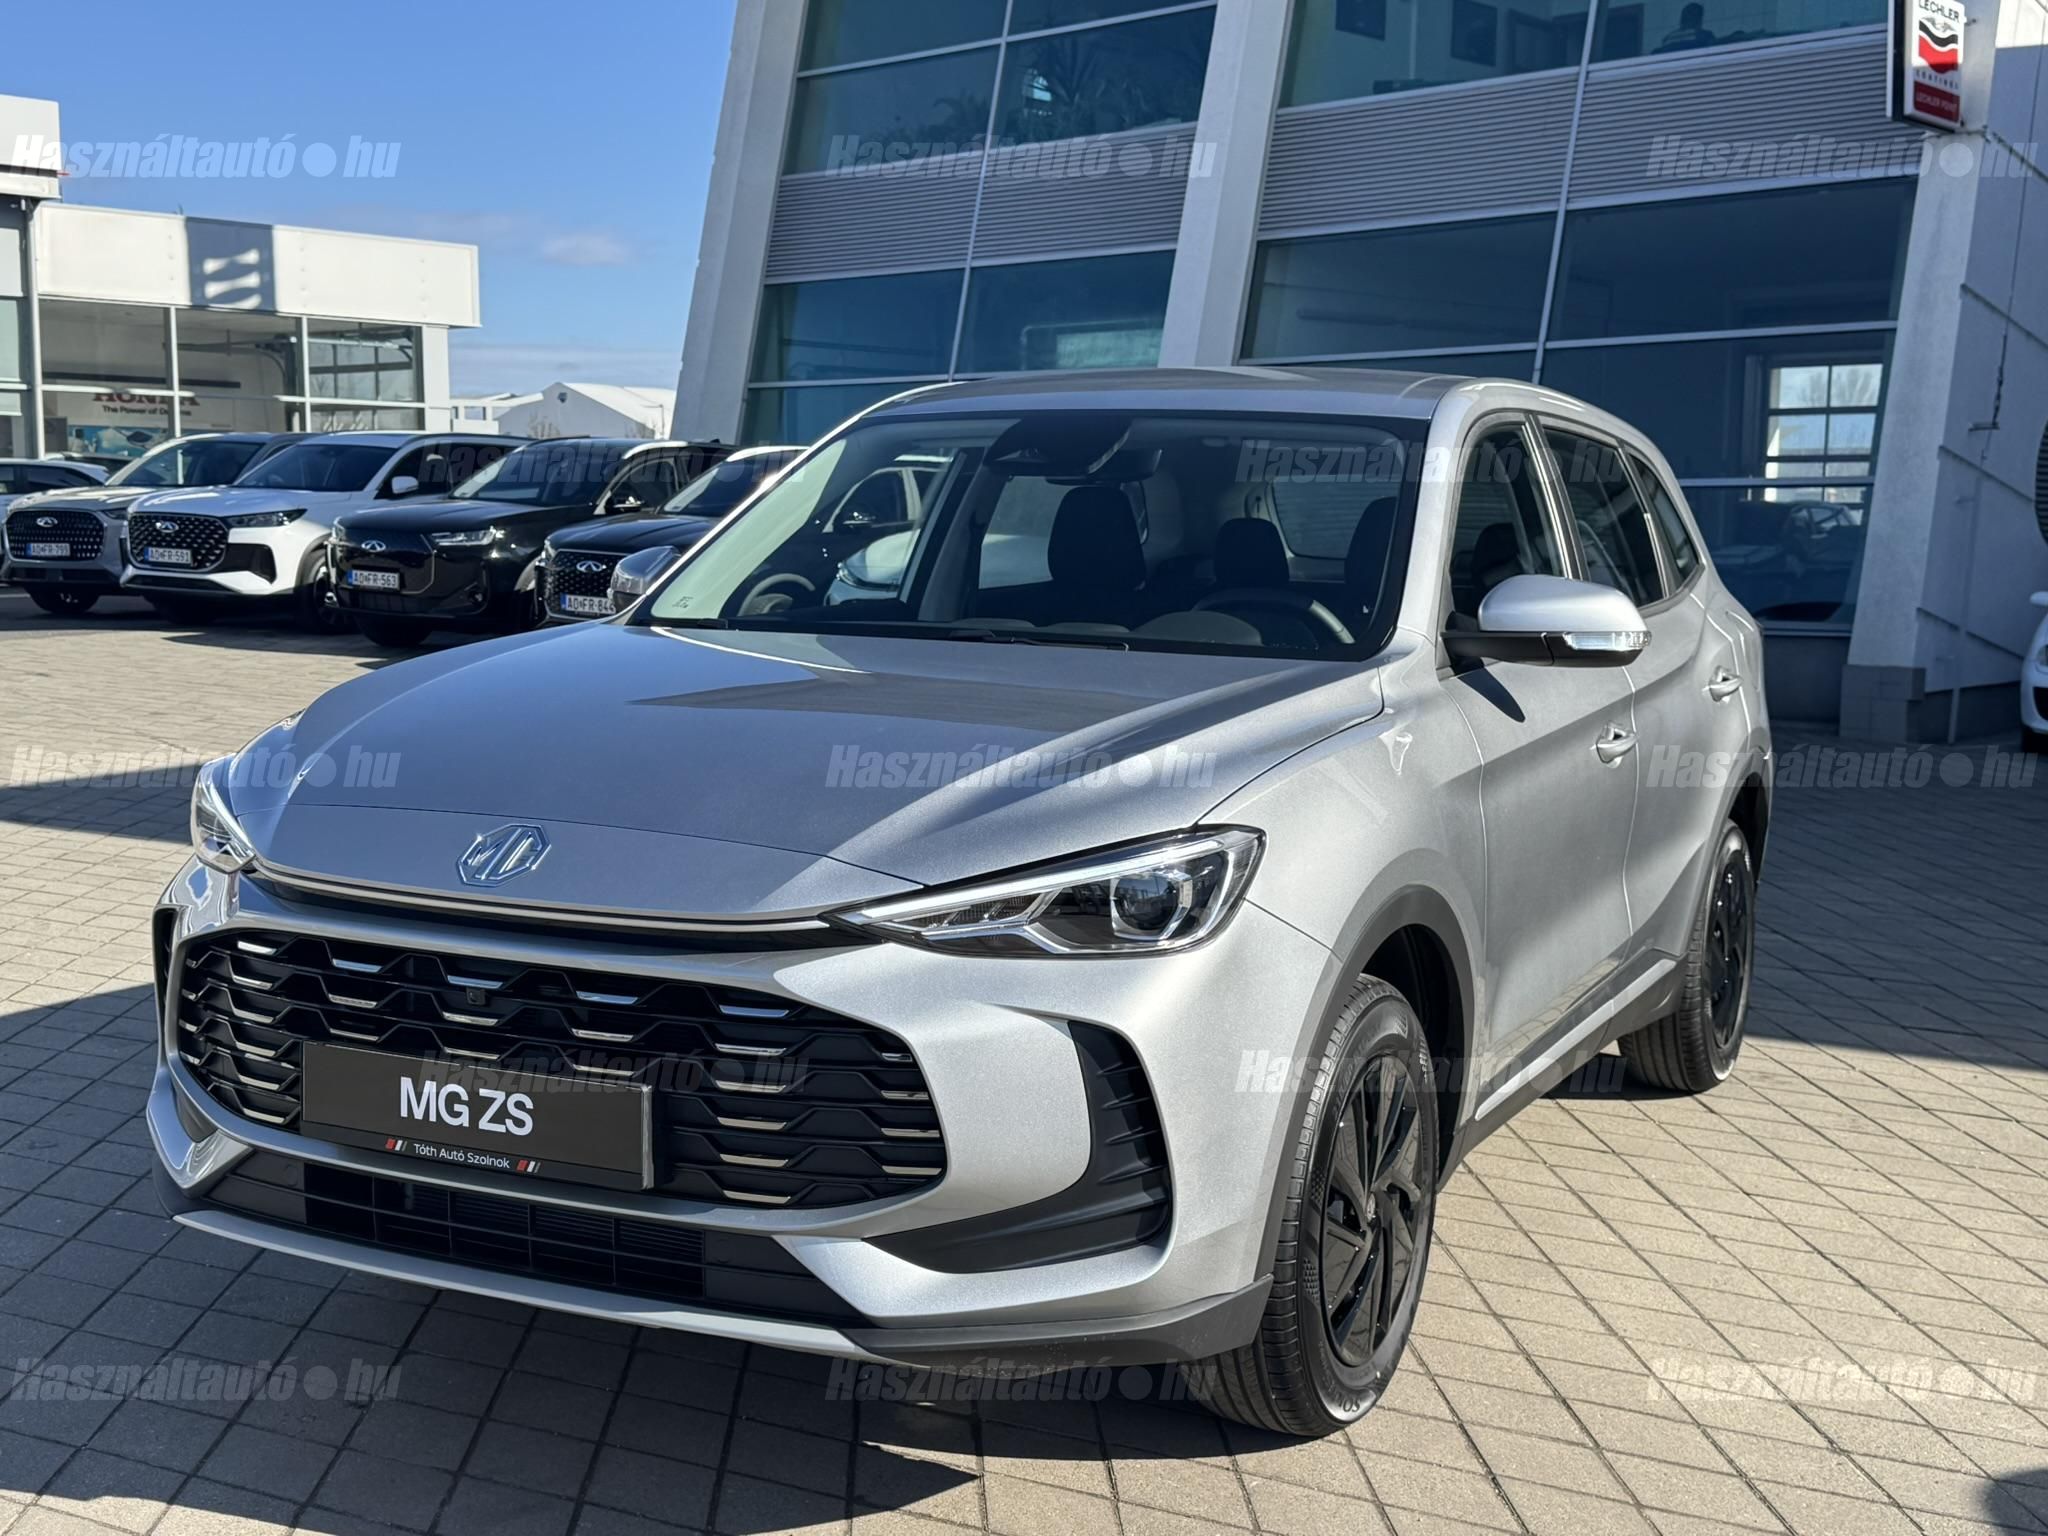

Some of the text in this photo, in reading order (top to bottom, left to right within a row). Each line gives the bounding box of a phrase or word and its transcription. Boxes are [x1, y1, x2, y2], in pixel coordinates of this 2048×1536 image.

[399, 1076, 535, 1136] MG ZS
[413, 1142, 510, 1169] Tóth Autó Szolnok
